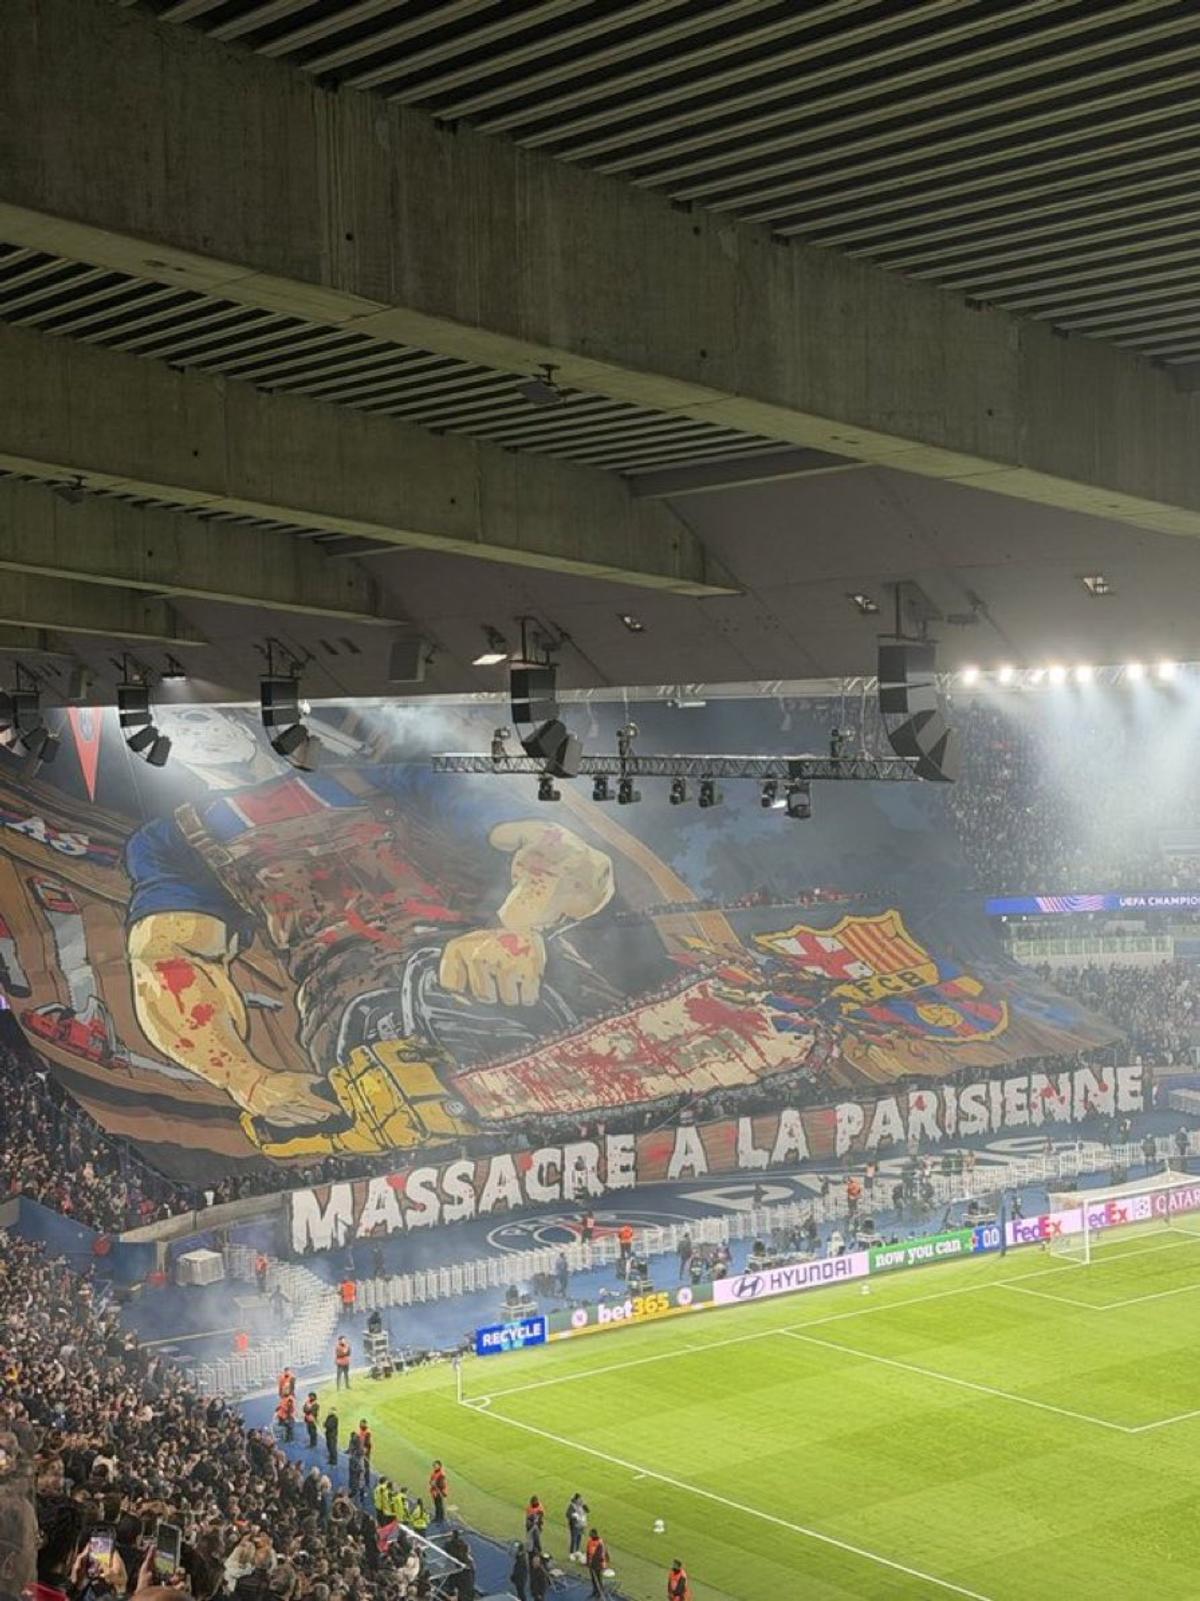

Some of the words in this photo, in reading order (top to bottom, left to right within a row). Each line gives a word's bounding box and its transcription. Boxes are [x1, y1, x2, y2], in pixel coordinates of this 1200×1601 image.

[1119, 896, 1145, 907] UEFA
[1148, 896, 1200, 906] CHAMPIO
[855, 972, 926, 997] FCB
[291, 1134, 636, 1254] MASSACRE
[667, 1125, 708, 1180] A
[737, 1109, 810, 1169] LA
[835, 1066, 1144, 1158] PARISIENNE
[1087, 1199, 1128, 1228] edEx
[1012, 1216, 1062, 1243] FedEx
[875, 1251, 905, 1268] now
[908, 1244, 933, 1264] you
[935, 1239, 961, 1253] can
[770, 1258, 852, 1290] HYUNDAI
[597, 1292, 669, 1324] bet365
[482, 1323, 542, 1347] RECYCLE
